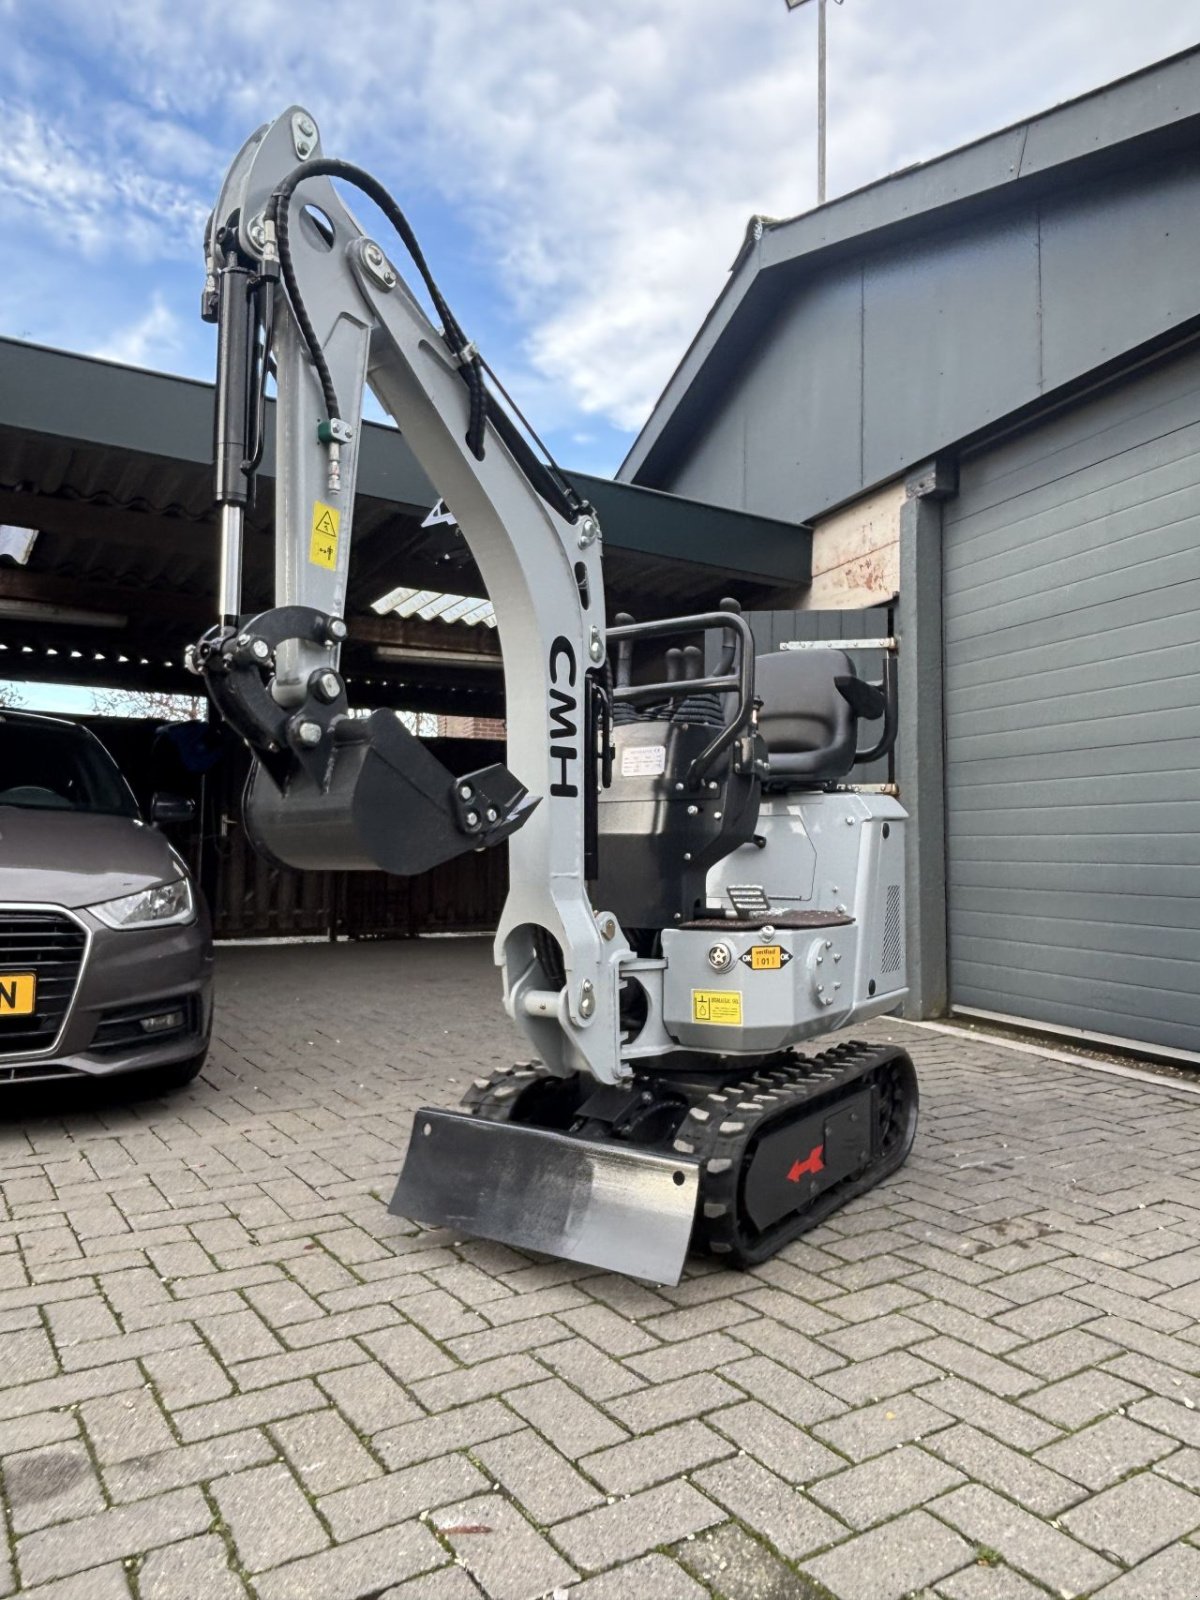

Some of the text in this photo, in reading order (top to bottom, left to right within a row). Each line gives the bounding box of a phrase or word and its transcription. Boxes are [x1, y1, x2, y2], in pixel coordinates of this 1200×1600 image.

[549, 635, 578, 797] CMH
[742, 954, 752, 962] OK
[780, 953, 790, 961] OK
